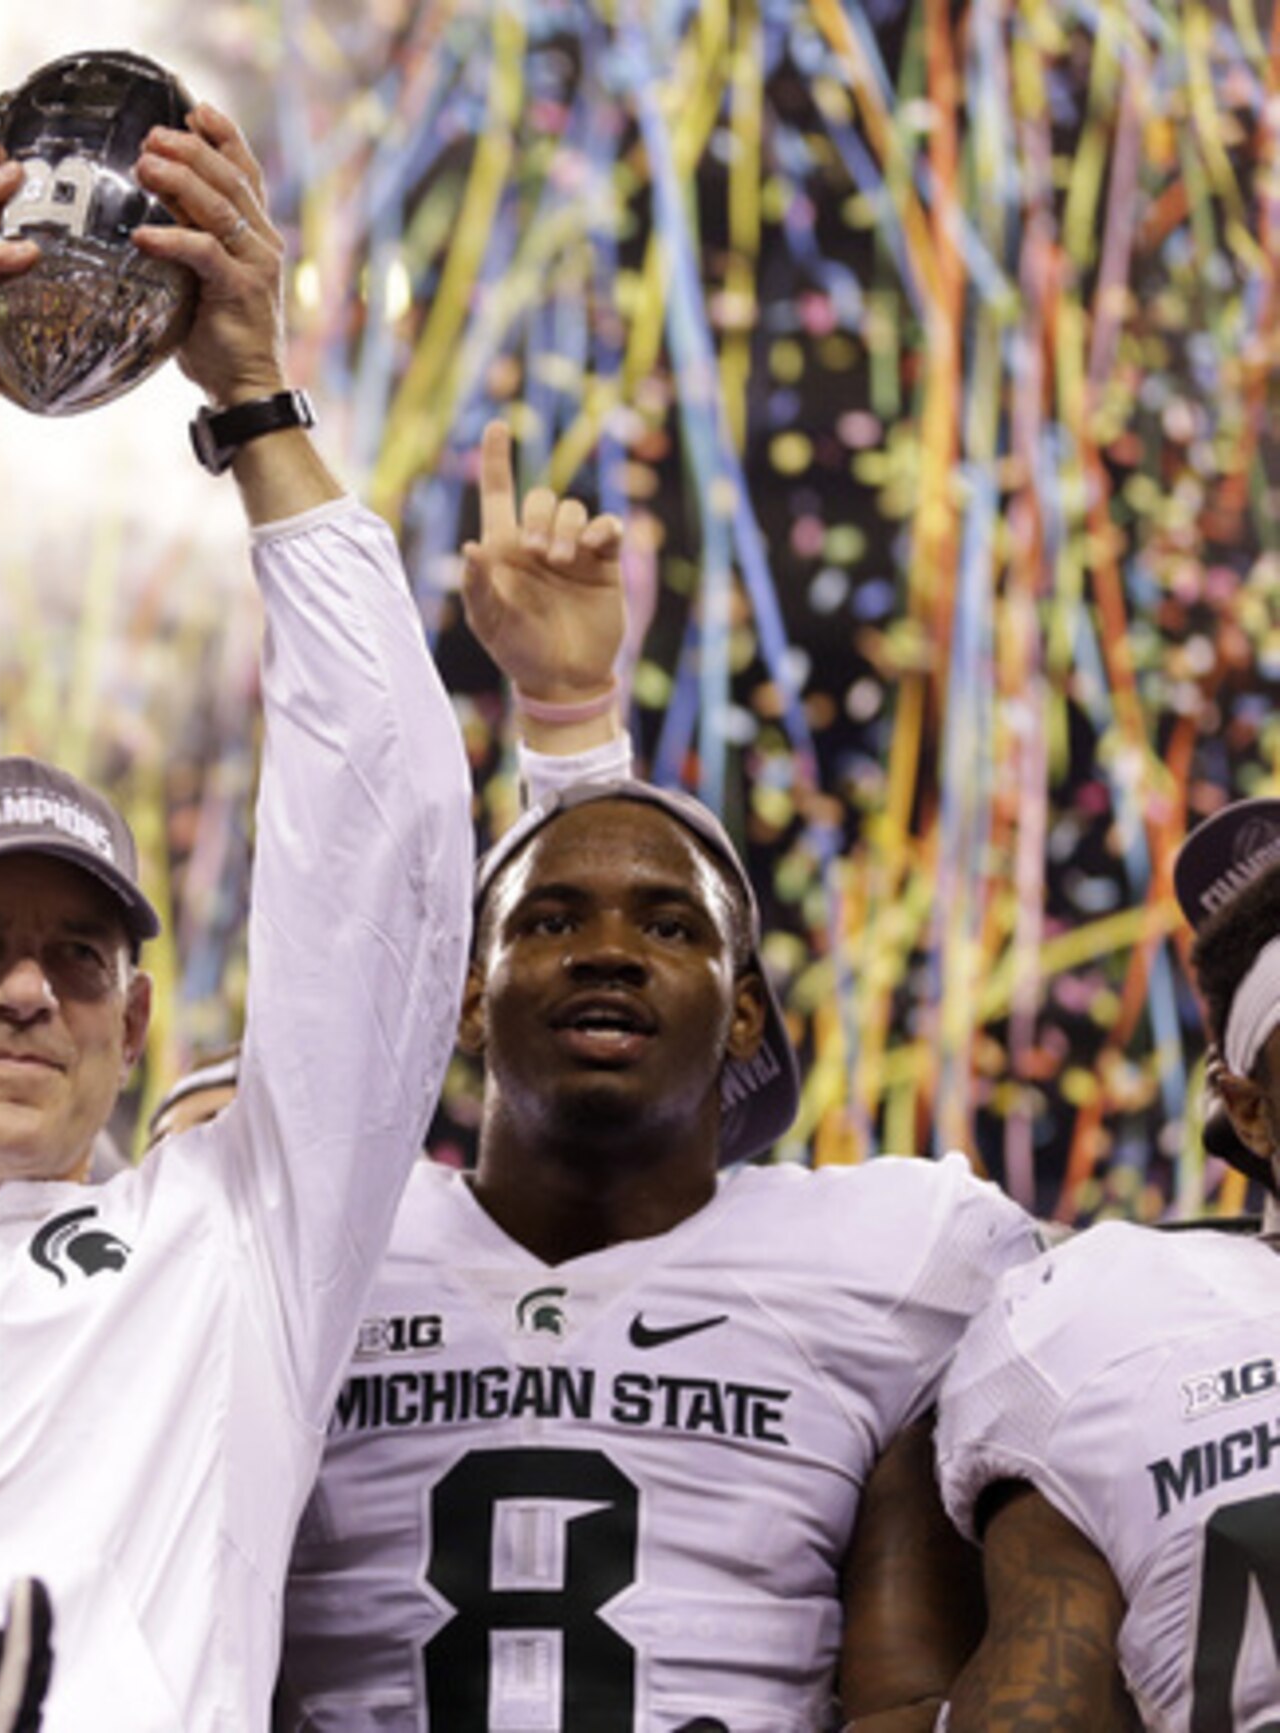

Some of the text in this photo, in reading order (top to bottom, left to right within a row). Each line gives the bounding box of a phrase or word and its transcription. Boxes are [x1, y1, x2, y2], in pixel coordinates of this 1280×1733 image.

[334, 1366, 791, 1446] MICHIGAN STATE
[422, 1446, 640, 1733] 8
